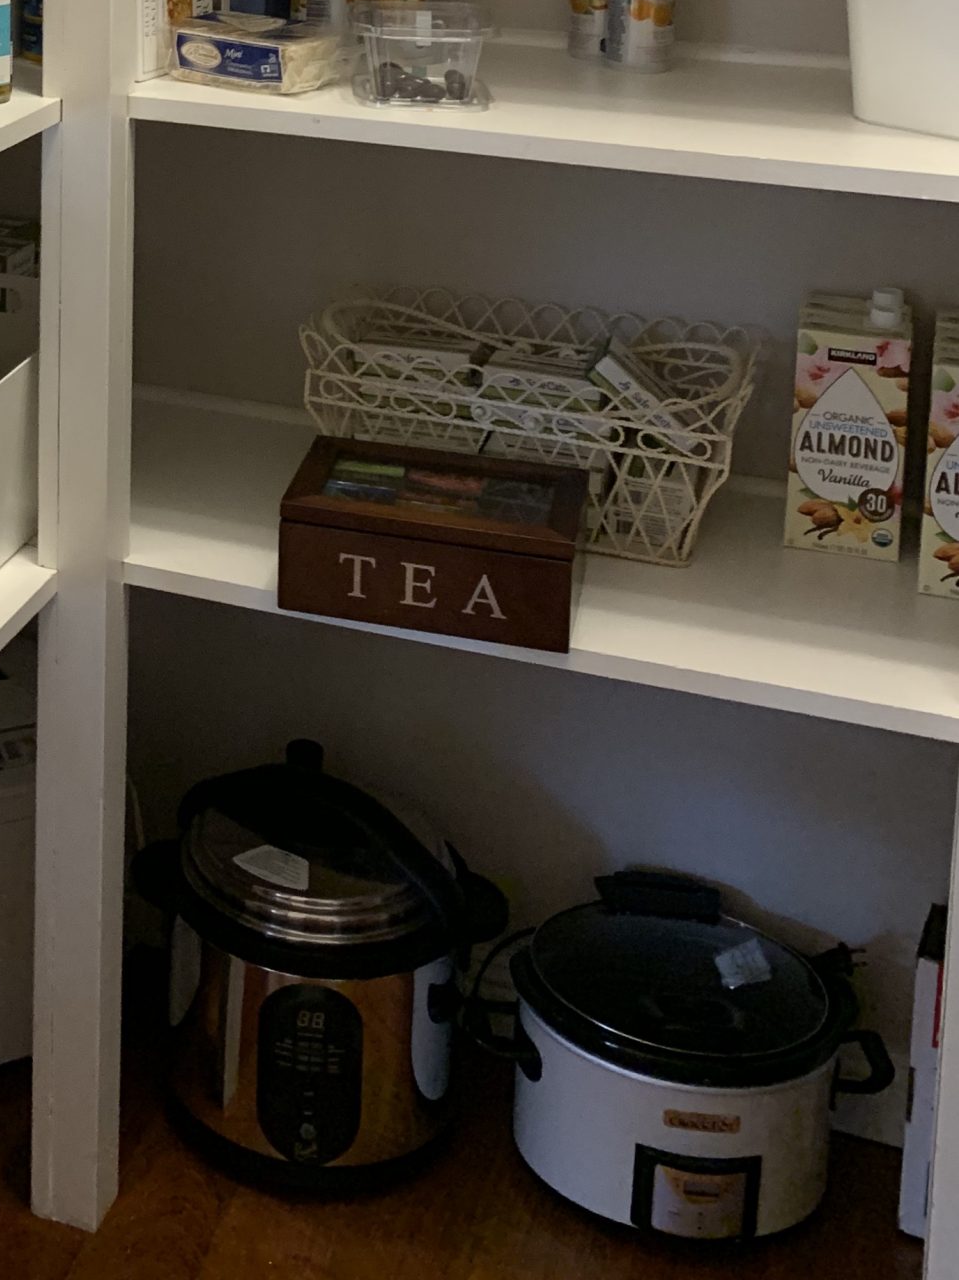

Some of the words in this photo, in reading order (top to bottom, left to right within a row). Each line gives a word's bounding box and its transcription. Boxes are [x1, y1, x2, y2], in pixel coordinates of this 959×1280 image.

[830, 349, 876, 362] KIRKLAND
[822, 411, 874, 426] ORGANIC
[809, 420, 888, 438] UNSWEETENED
[799, 430, 894, 463] ALMOND
[817, 468, 871, 488] Vanilla
[866, 492, 887, 513] 30
[339, 552, 507, 620] TEA
